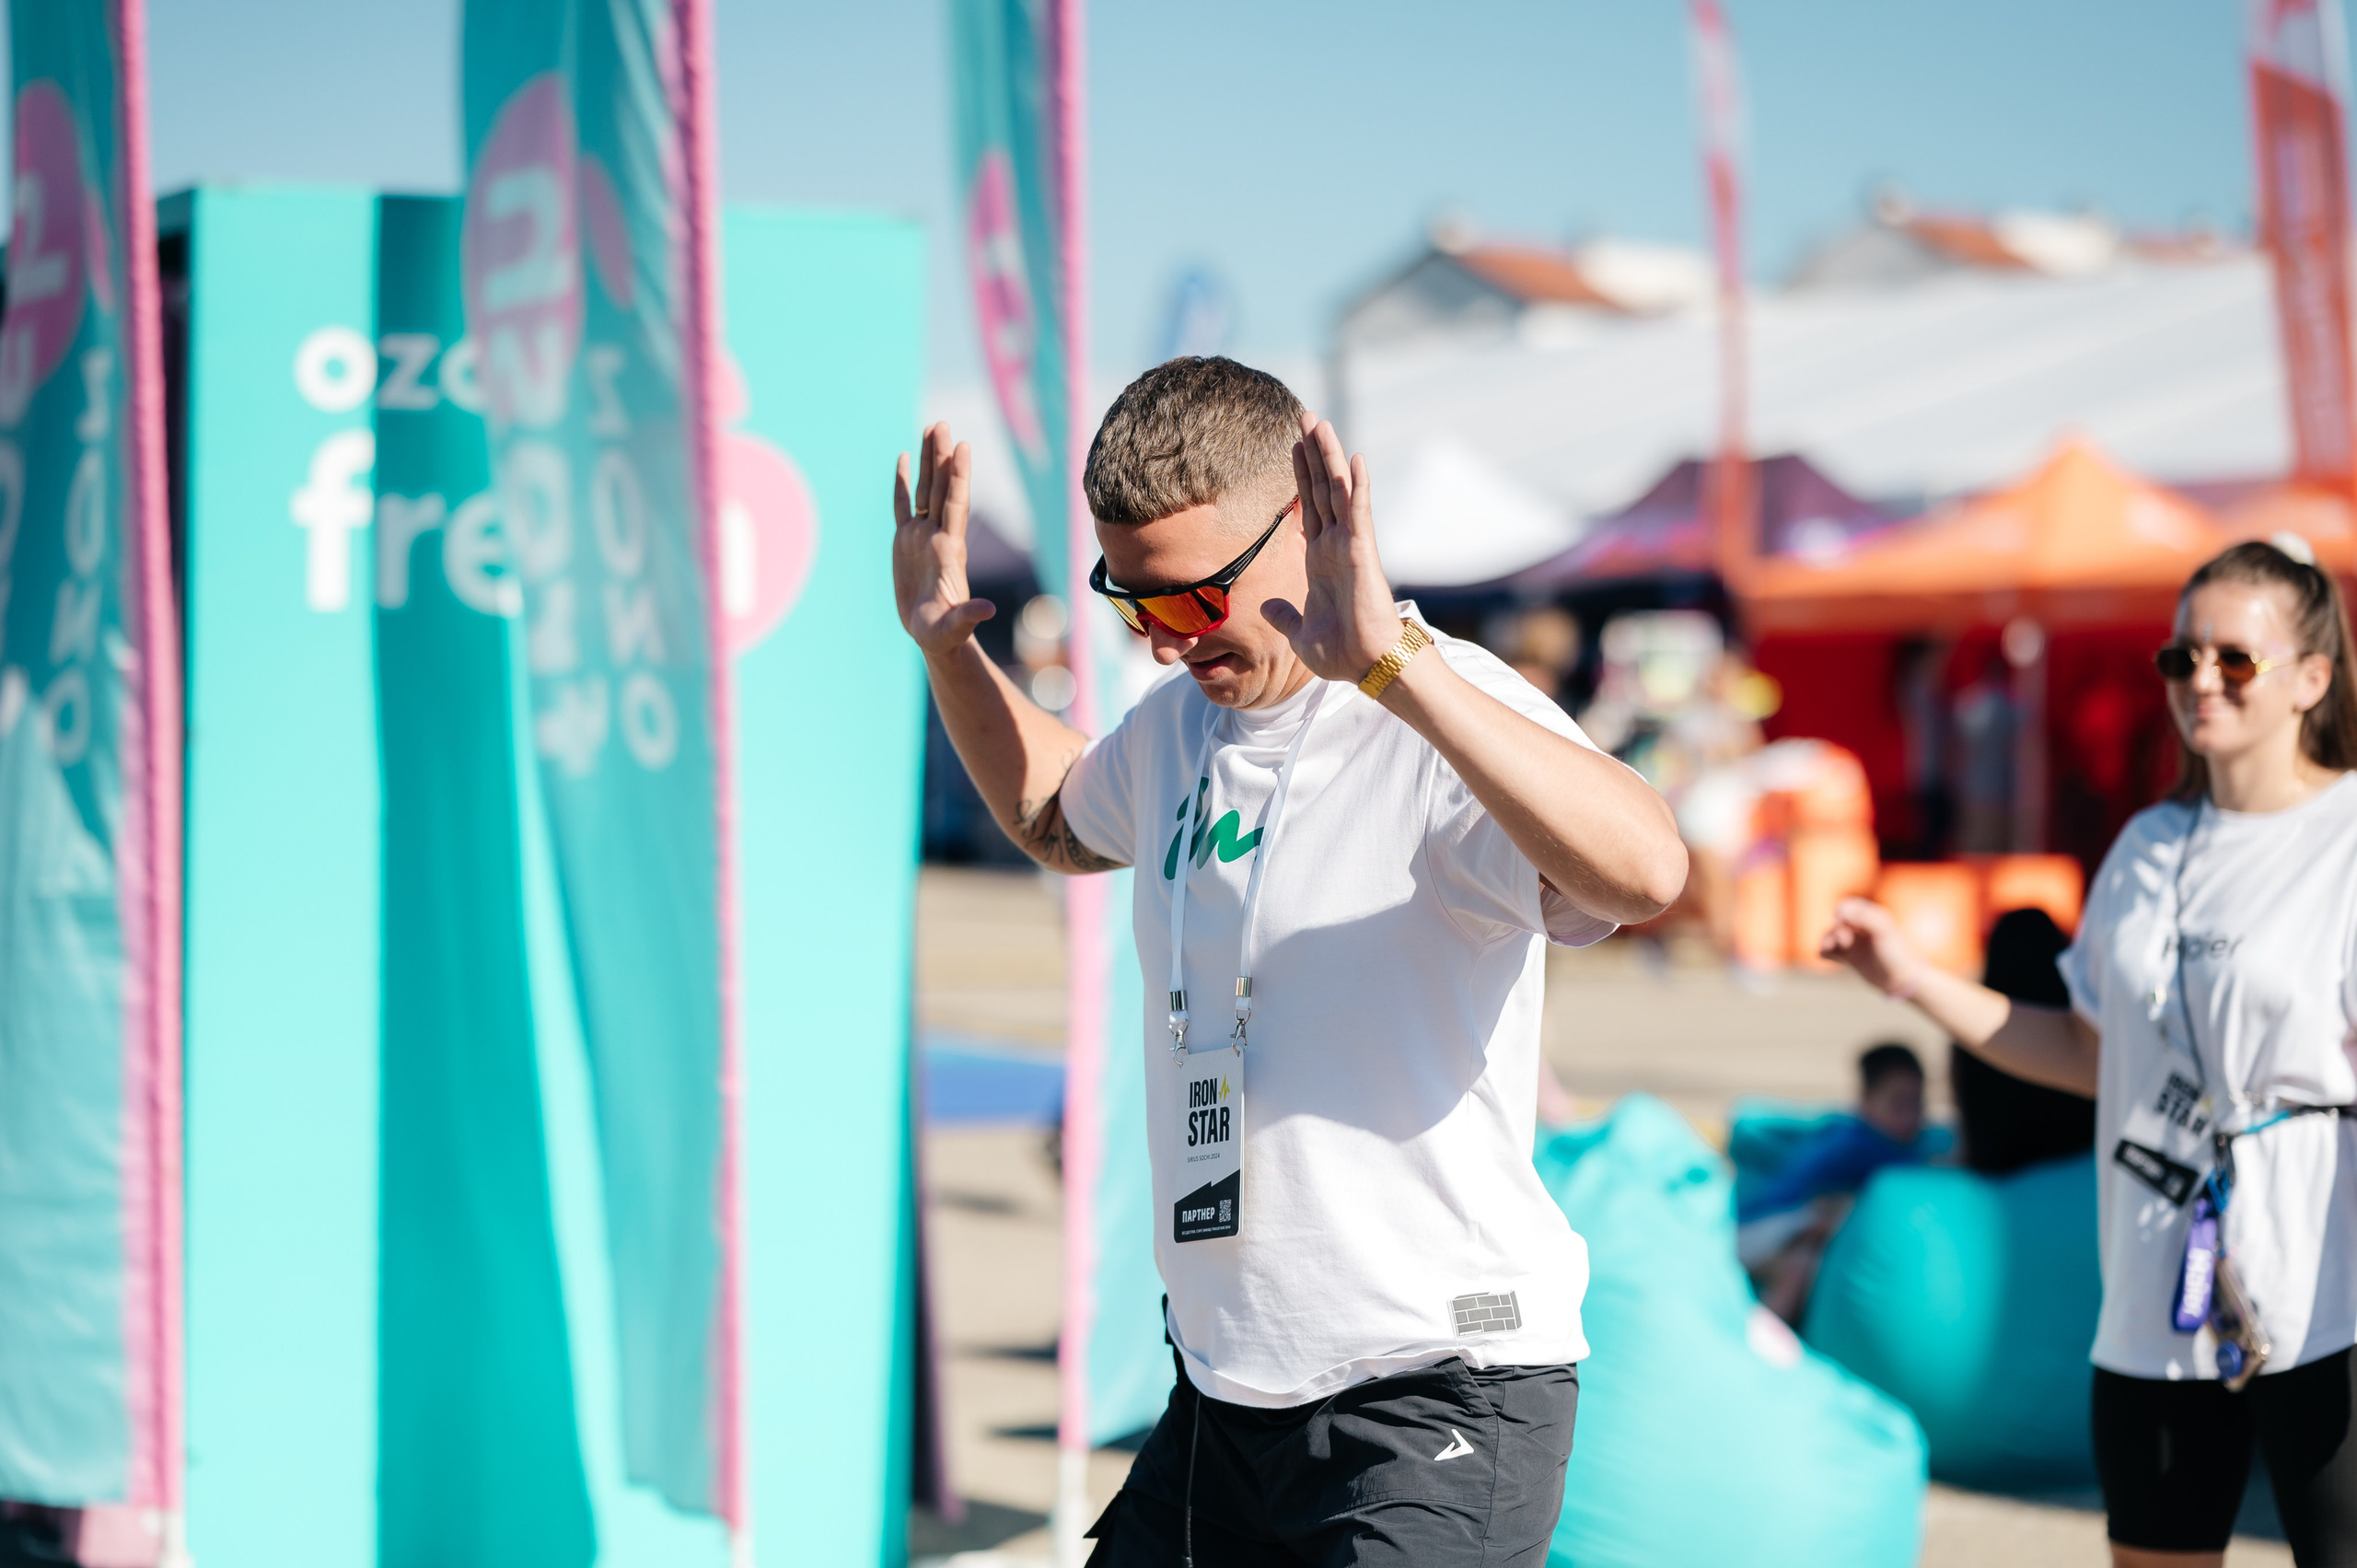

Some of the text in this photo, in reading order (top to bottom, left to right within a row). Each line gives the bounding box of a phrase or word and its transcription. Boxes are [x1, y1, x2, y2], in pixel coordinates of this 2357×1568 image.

[1189, 1077, 1218, 1109] IRON
[1188, 1106, 1230, 1147] STAR
[1199, 1154, 1211, 1162] SOCHI
[1181, 1206, 1215, 1224] ПАРТНЕР
